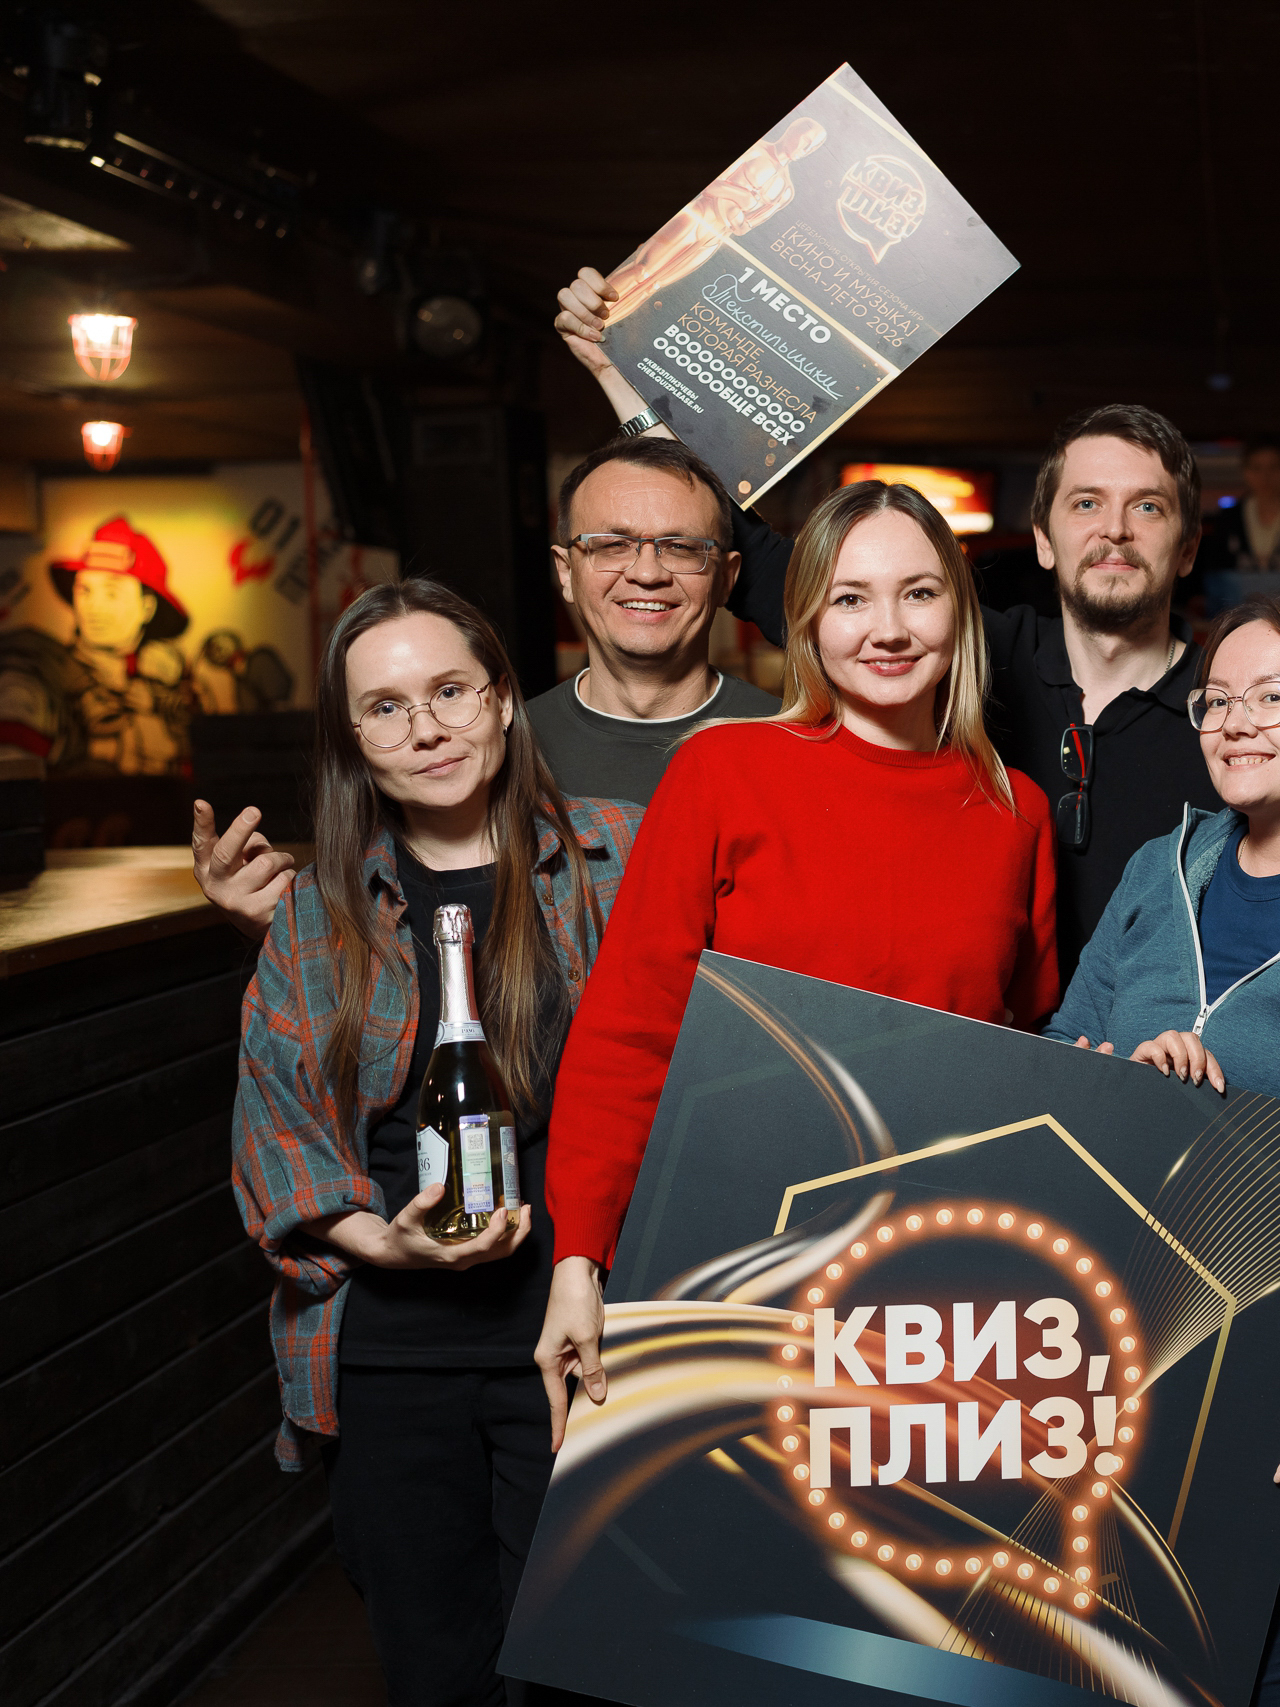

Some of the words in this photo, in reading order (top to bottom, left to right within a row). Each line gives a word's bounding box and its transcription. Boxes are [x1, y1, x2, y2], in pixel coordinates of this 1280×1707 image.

[737, 266, 755, 284] 1
[751, 278, 831, 344] МЕСТО
[770, 239, 868, 317] ВЕСНА-ЛЕТО
[866, 316, 905, 348] 2026
[781, 225, 835, 269] [КИНО
[834, 267, 850, 282] И
[848, 278, 920, 337] МУЗЫКА]
[795, 219, 841, 256] ЦЕРЕМОНИЯ
[840, 250, 880, 287] ОТКРЫТИЯ
[878, 285, 909, 311] СЕЗОНА
[908, 307, 924, 322] ИГР
[643, 357, 699, 401] #КВИЗПЛИЗЧЕБЫ
[664, 324, 806, 433] ВООООООООООО
[677, 313, 746, 367] КОТОРАЯ
[742, 363, 818, 423] РАЗНЕСЛА
[690, 302, 765, 363] КОМАНДЕ,
[637, 362, 704, 414] CHEB.QUIZPLEASE.RU
[653, 337, 757, 417] ООООООБЩЕ
[752, 412, 795, 446] ВСЕХ
[813, 1297, 1111, 1392] КВИЗ,
[809, 1395, 1117, 1489] ПЛИЗ!
